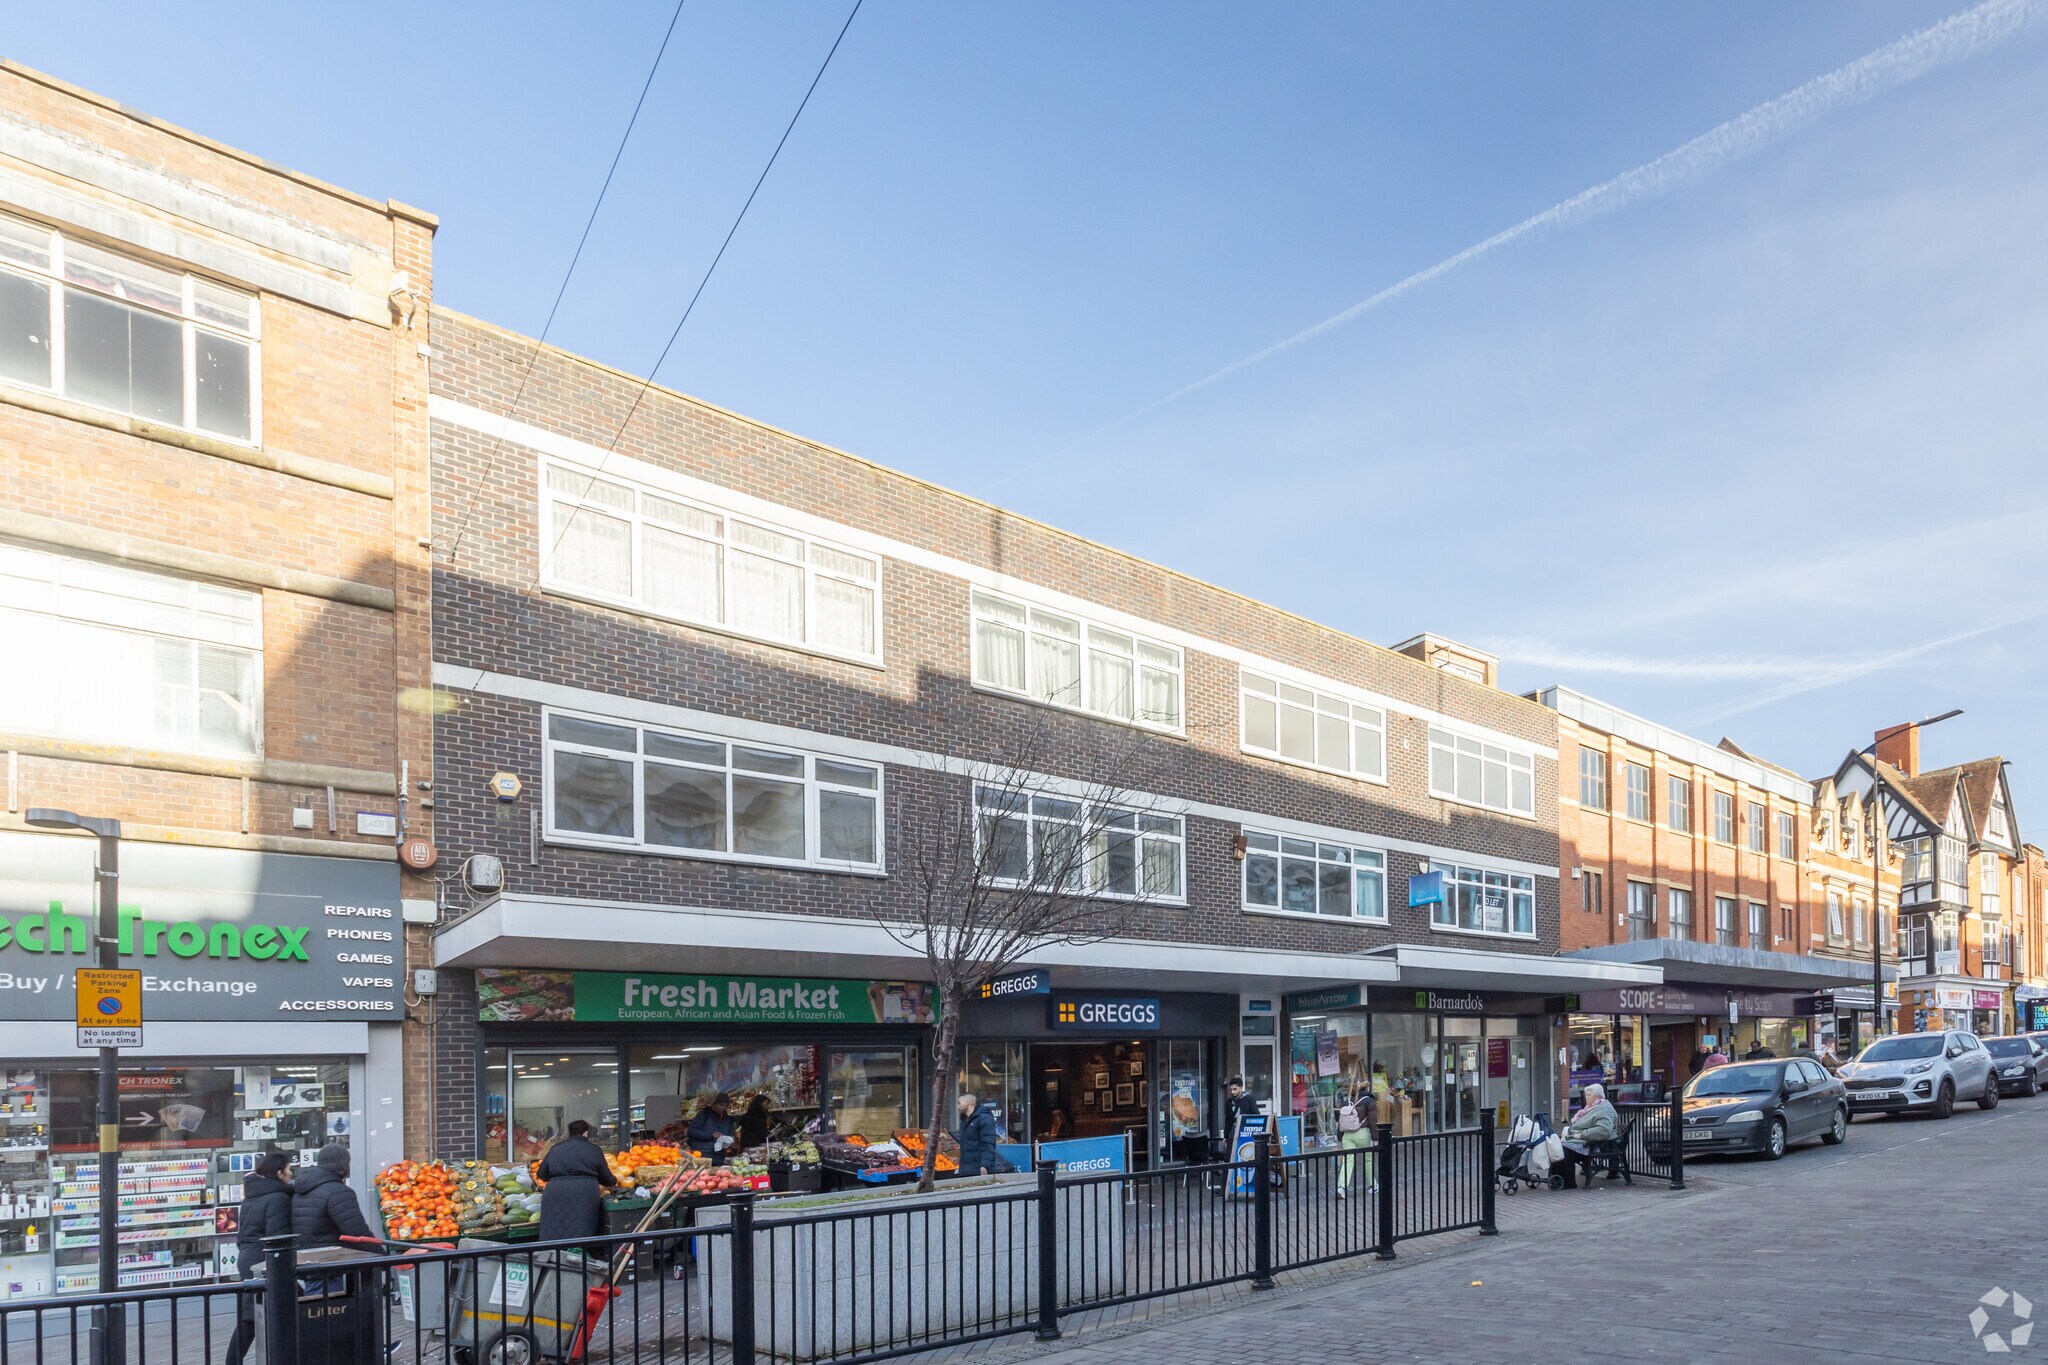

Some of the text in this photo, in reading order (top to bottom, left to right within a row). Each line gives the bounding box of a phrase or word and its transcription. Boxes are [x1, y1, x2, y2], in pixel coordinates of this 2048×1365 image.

[324, 905, 392, 918] REPAIRS
[327, 929, 393, 941] PHONES
[337, 953, 393, 965] GAMES
[0, 972, 48, 994] Buy
[142, 976, 258, 997] Exchange
[342, 977, 394, 988] VAPES
[992, 975, 1038, 996] GREGGS
[624, 978, 840, 1010] Fresh Market
[1428, 992, 1483, 1010] Barnardo's
[1620, 989, 1656, 1009] SCOPE
[279, 1000, 394, 1011] ACCESSORIES
[1079, 1003, 1156, 1023] GREGGS
[618, 1008, 845, 1020] European, African and Asian Food & Frozen Fish
[138, 1077, 183, 1085] TRONEX
[1068, 1157, 1111, 1172] GREGGS
